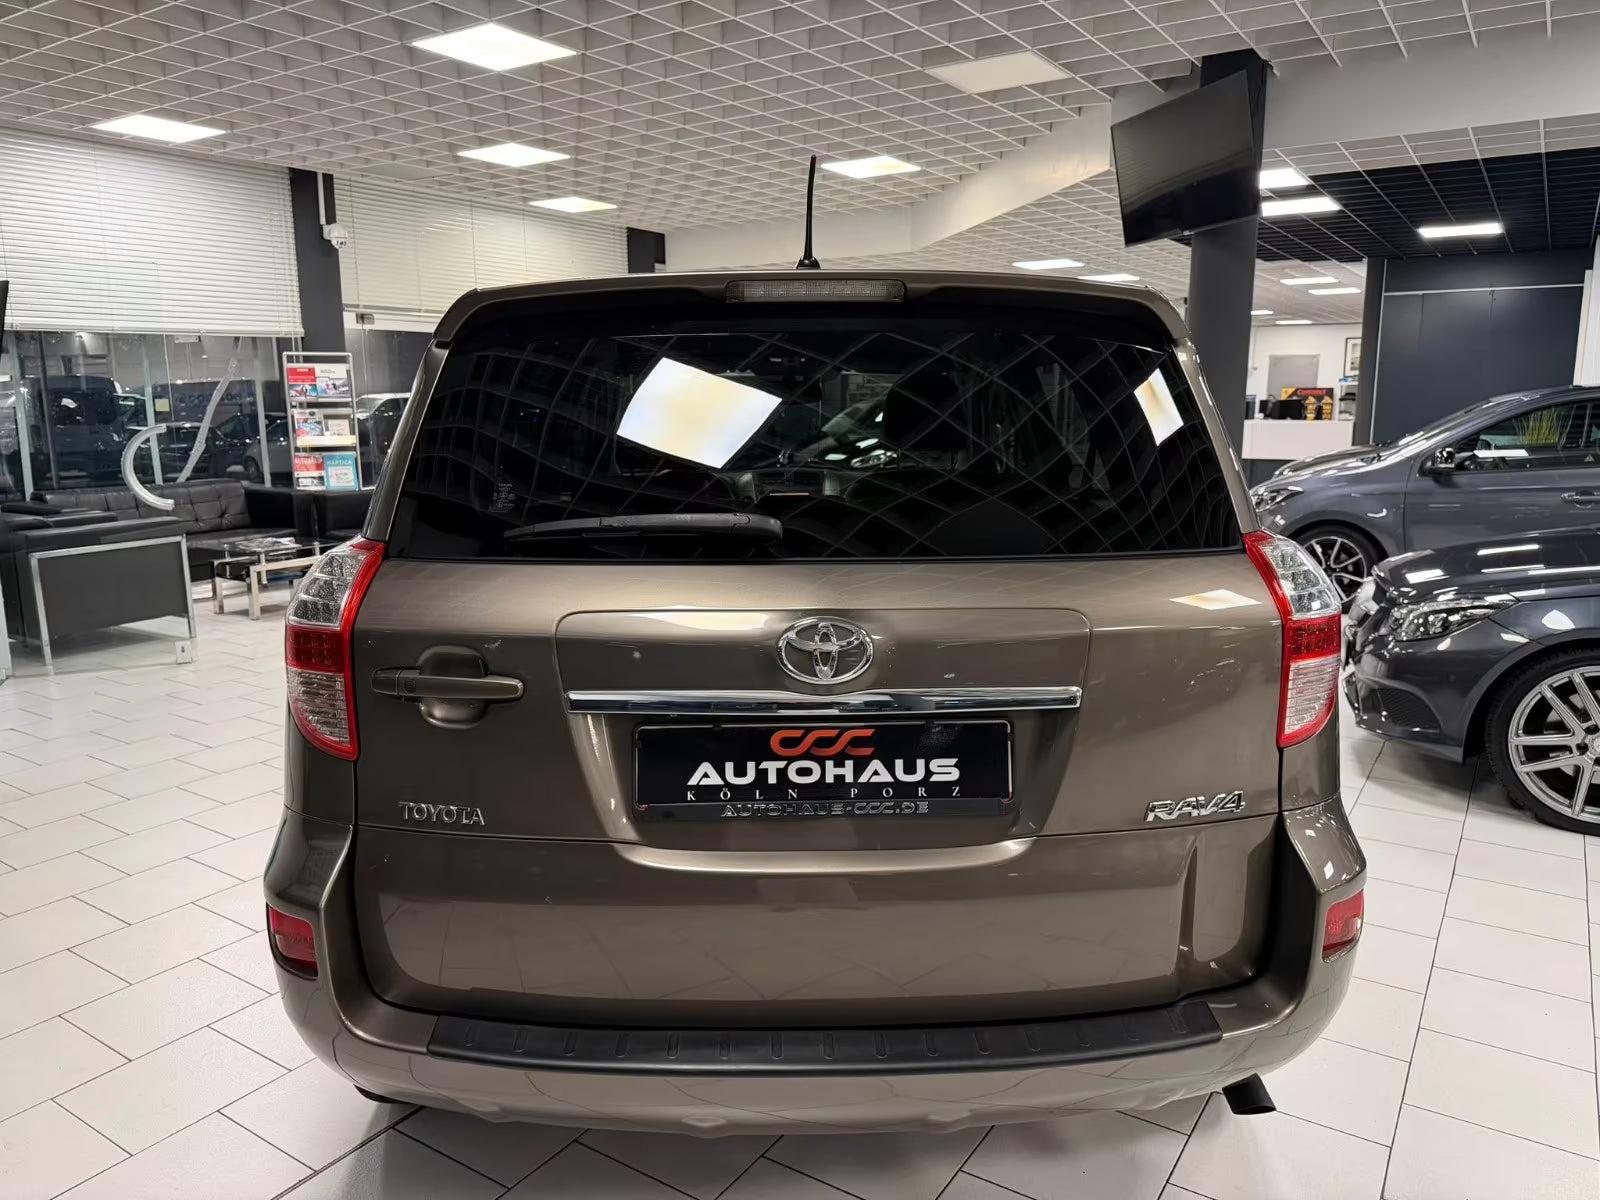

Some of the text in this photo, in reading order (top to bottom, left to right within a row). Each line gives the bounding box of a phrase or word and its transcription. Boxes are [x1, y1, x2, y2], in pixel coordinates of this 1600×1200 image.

[687, 758, 960, 786] AUTOHAUS
[687, 786, 960, 801] KÖLN PORZ
[398, 801, 485, 825] TOYOTA
[720, 801, 929, 817] AUTOHAUS-CCC.DE
[1144, 790, 1246, 822] RAV4
